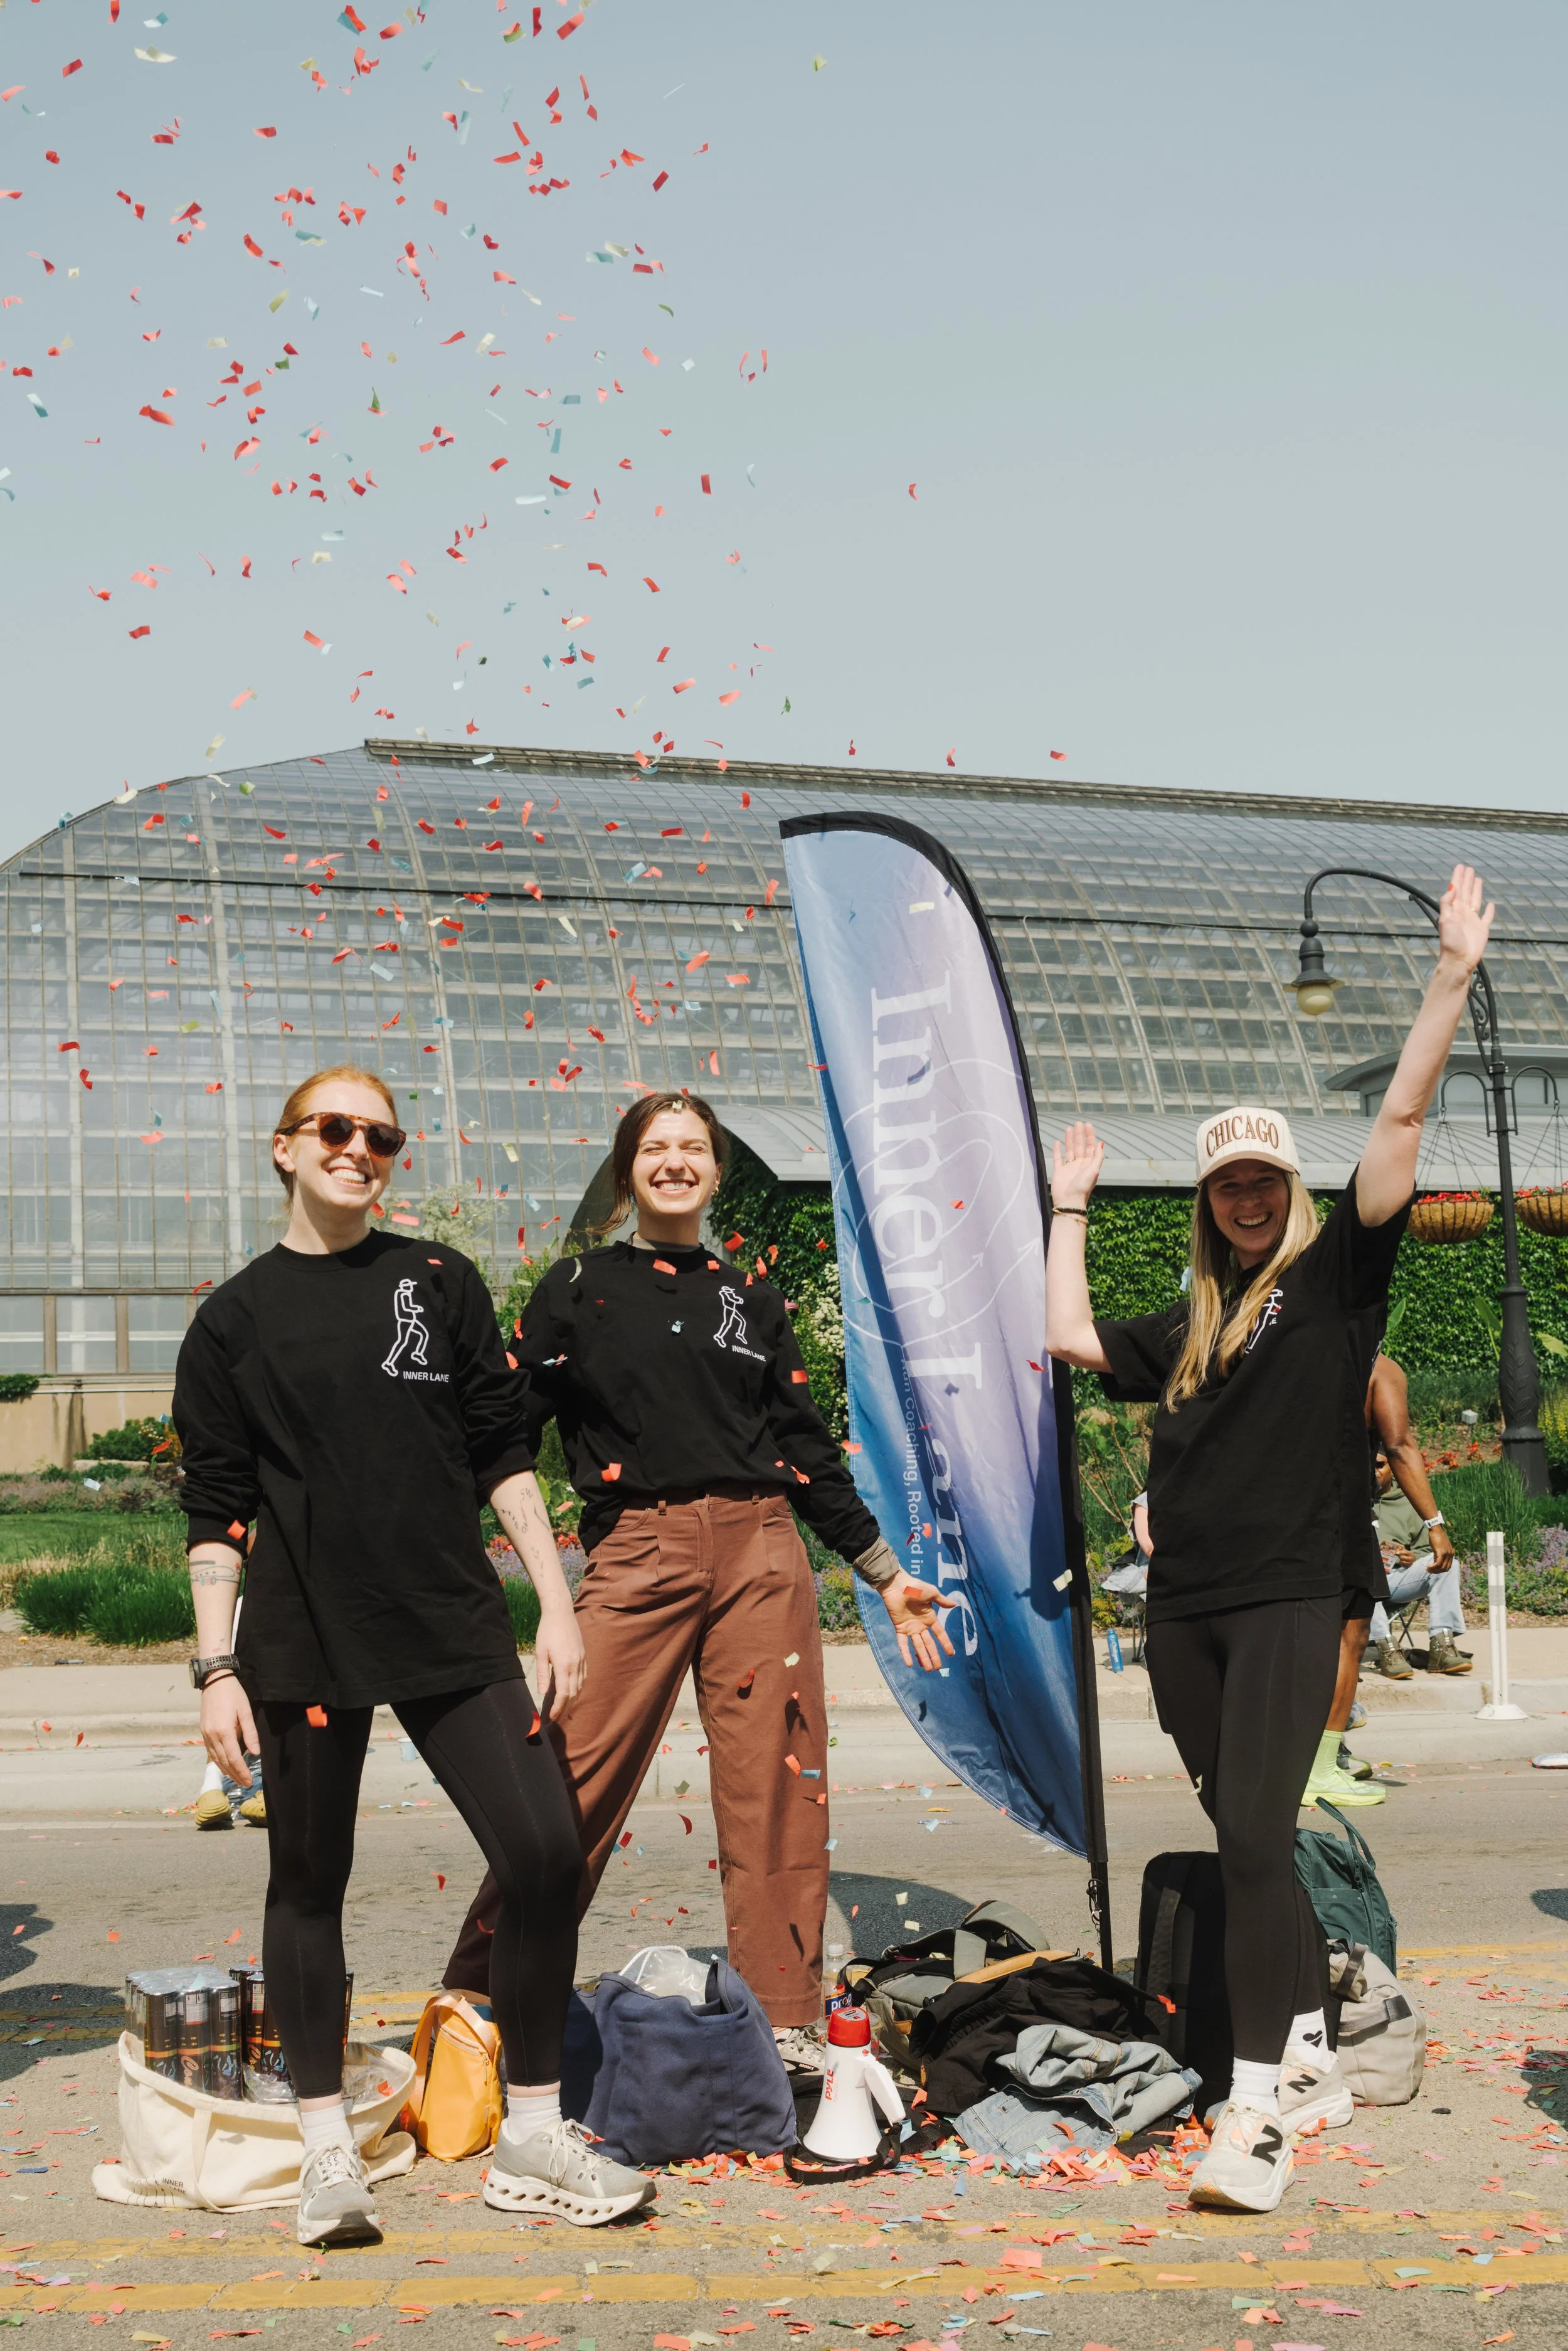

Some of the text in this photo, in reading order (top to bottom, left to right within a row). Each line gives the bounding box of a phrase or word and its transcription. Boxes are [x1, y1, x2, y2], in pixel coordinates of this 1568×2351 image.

[871, 970, 952, 1319] Inner
[1206, 1115, 1279, 1157] CHICAGO
[732, 1344, 766, 1362] INNER LANE
[403, 1371, 450, 1382] INNER LANE
[903, 1397, 920, 1486] Coaching,
[907, 1490, 924, 1554] Rooted
[911, 1559, 924, 1575] in
[825, 2068, 834, 2101] PYLE
[162, 2178, 184, 2188] INNER
